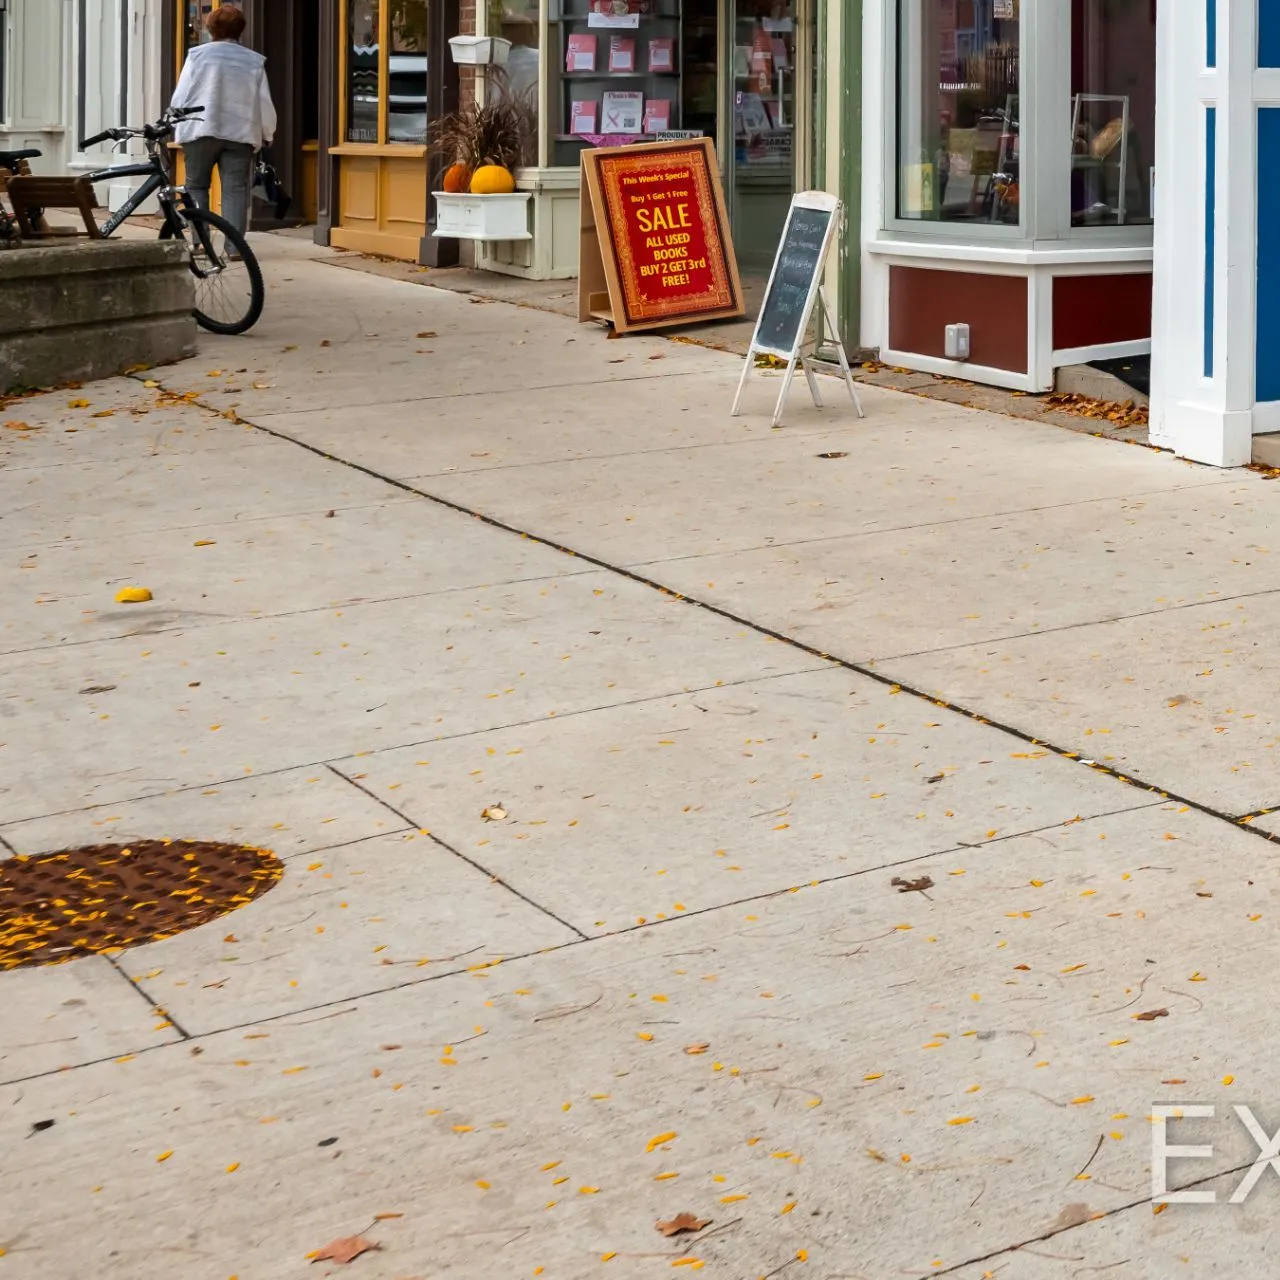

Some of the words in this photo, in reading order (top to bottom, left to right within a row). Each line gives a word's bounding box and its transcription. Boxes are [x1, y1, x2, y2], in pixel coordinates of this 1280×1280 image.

[623, 177, 637, 185] This
[639, 174, 664, 184] Week's
[665, 171, 690, 181] Special
[631, 195, 645, 203] Buy
[672, 190, 689, 198] Free
[636, 204, 692, 233] SALE
[646, 237, 664, 248] ALL
[665, 233, 690, 246] USED
[653, 247, 688, 261] BOOKS
[640, 264, 660, 277] BUY
[662, 263, 668, 274] 2
[669, 259, 690, 272] GET
[688, 257, 706, 270] 3rd
[662, 273, 690, 288] FREE!
